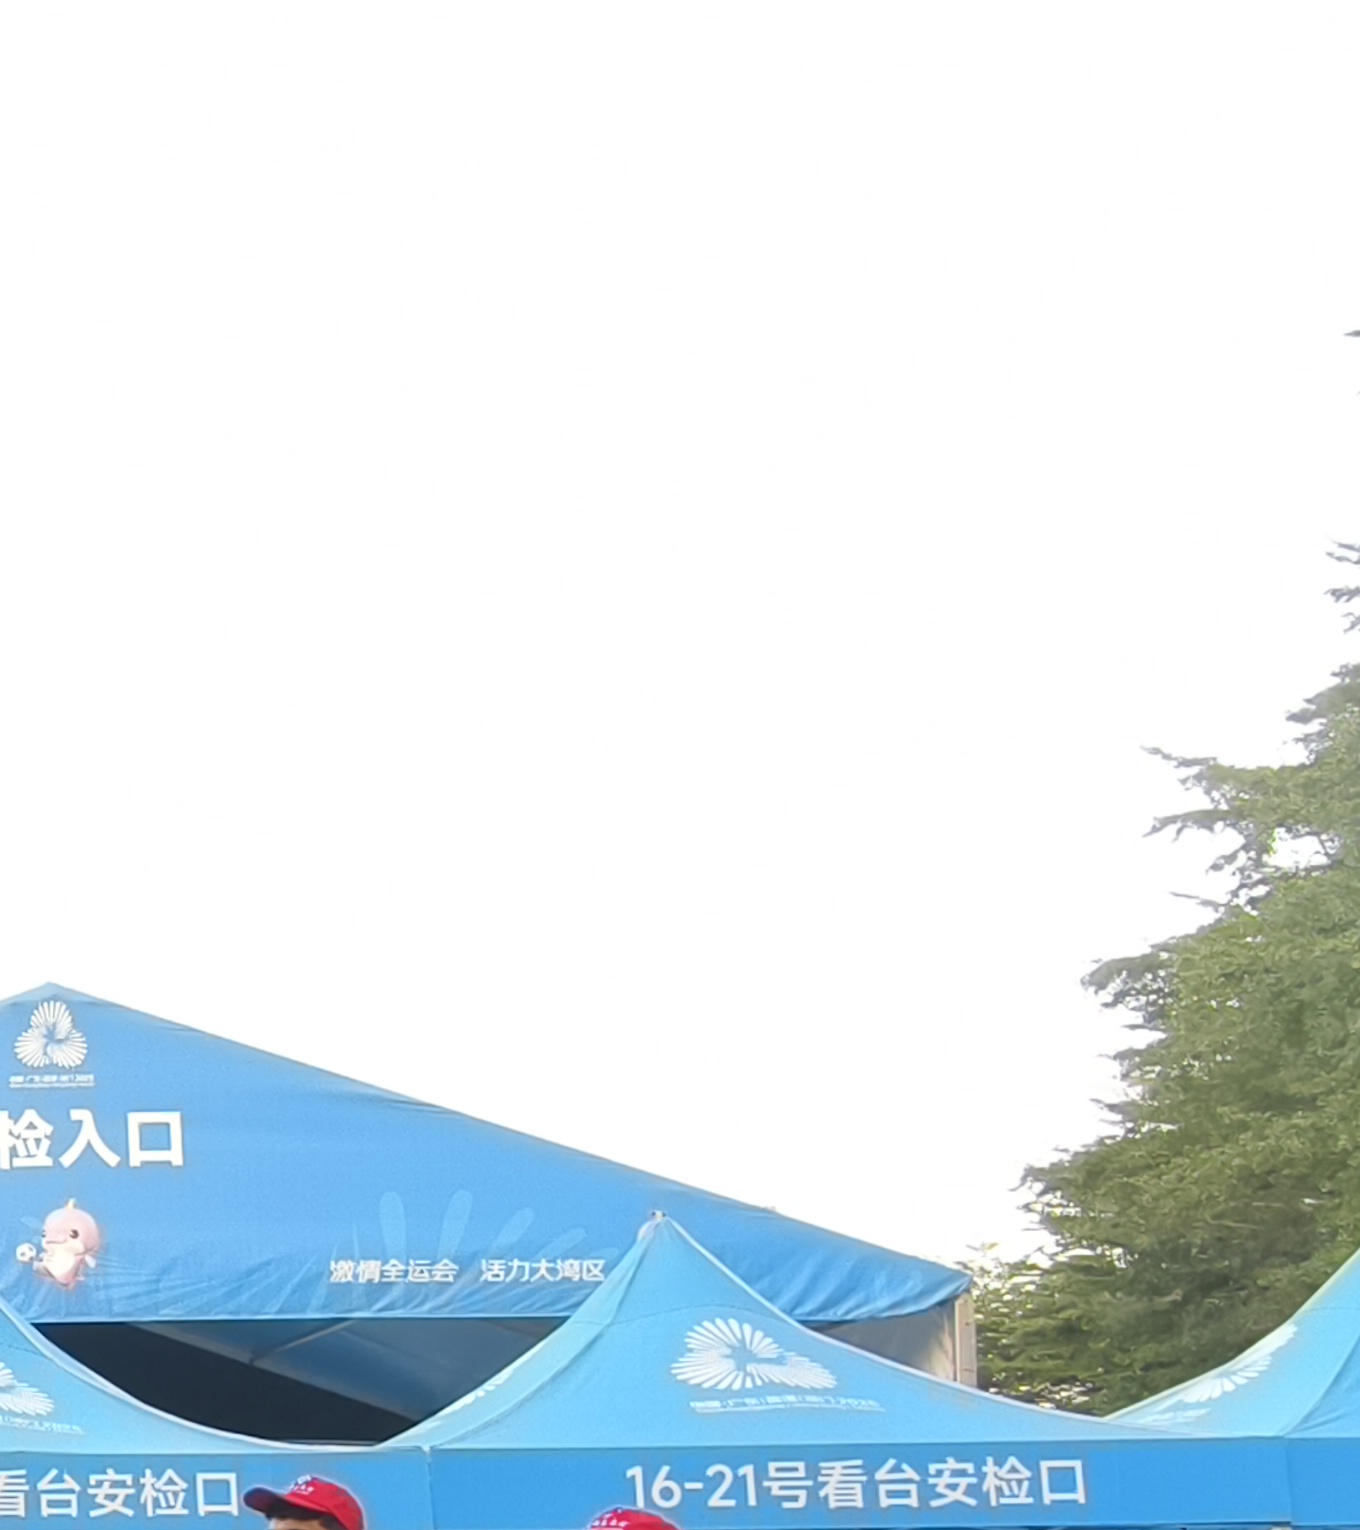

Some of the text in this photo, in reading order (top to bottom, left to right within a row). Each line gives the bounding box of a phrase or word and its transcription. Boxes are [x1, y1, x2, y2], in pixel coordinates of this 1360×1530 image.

[480, 1258, 606, 1283] 活力大湾区
[624, 1456, 1087, 1509] 16-21号看台安检口
